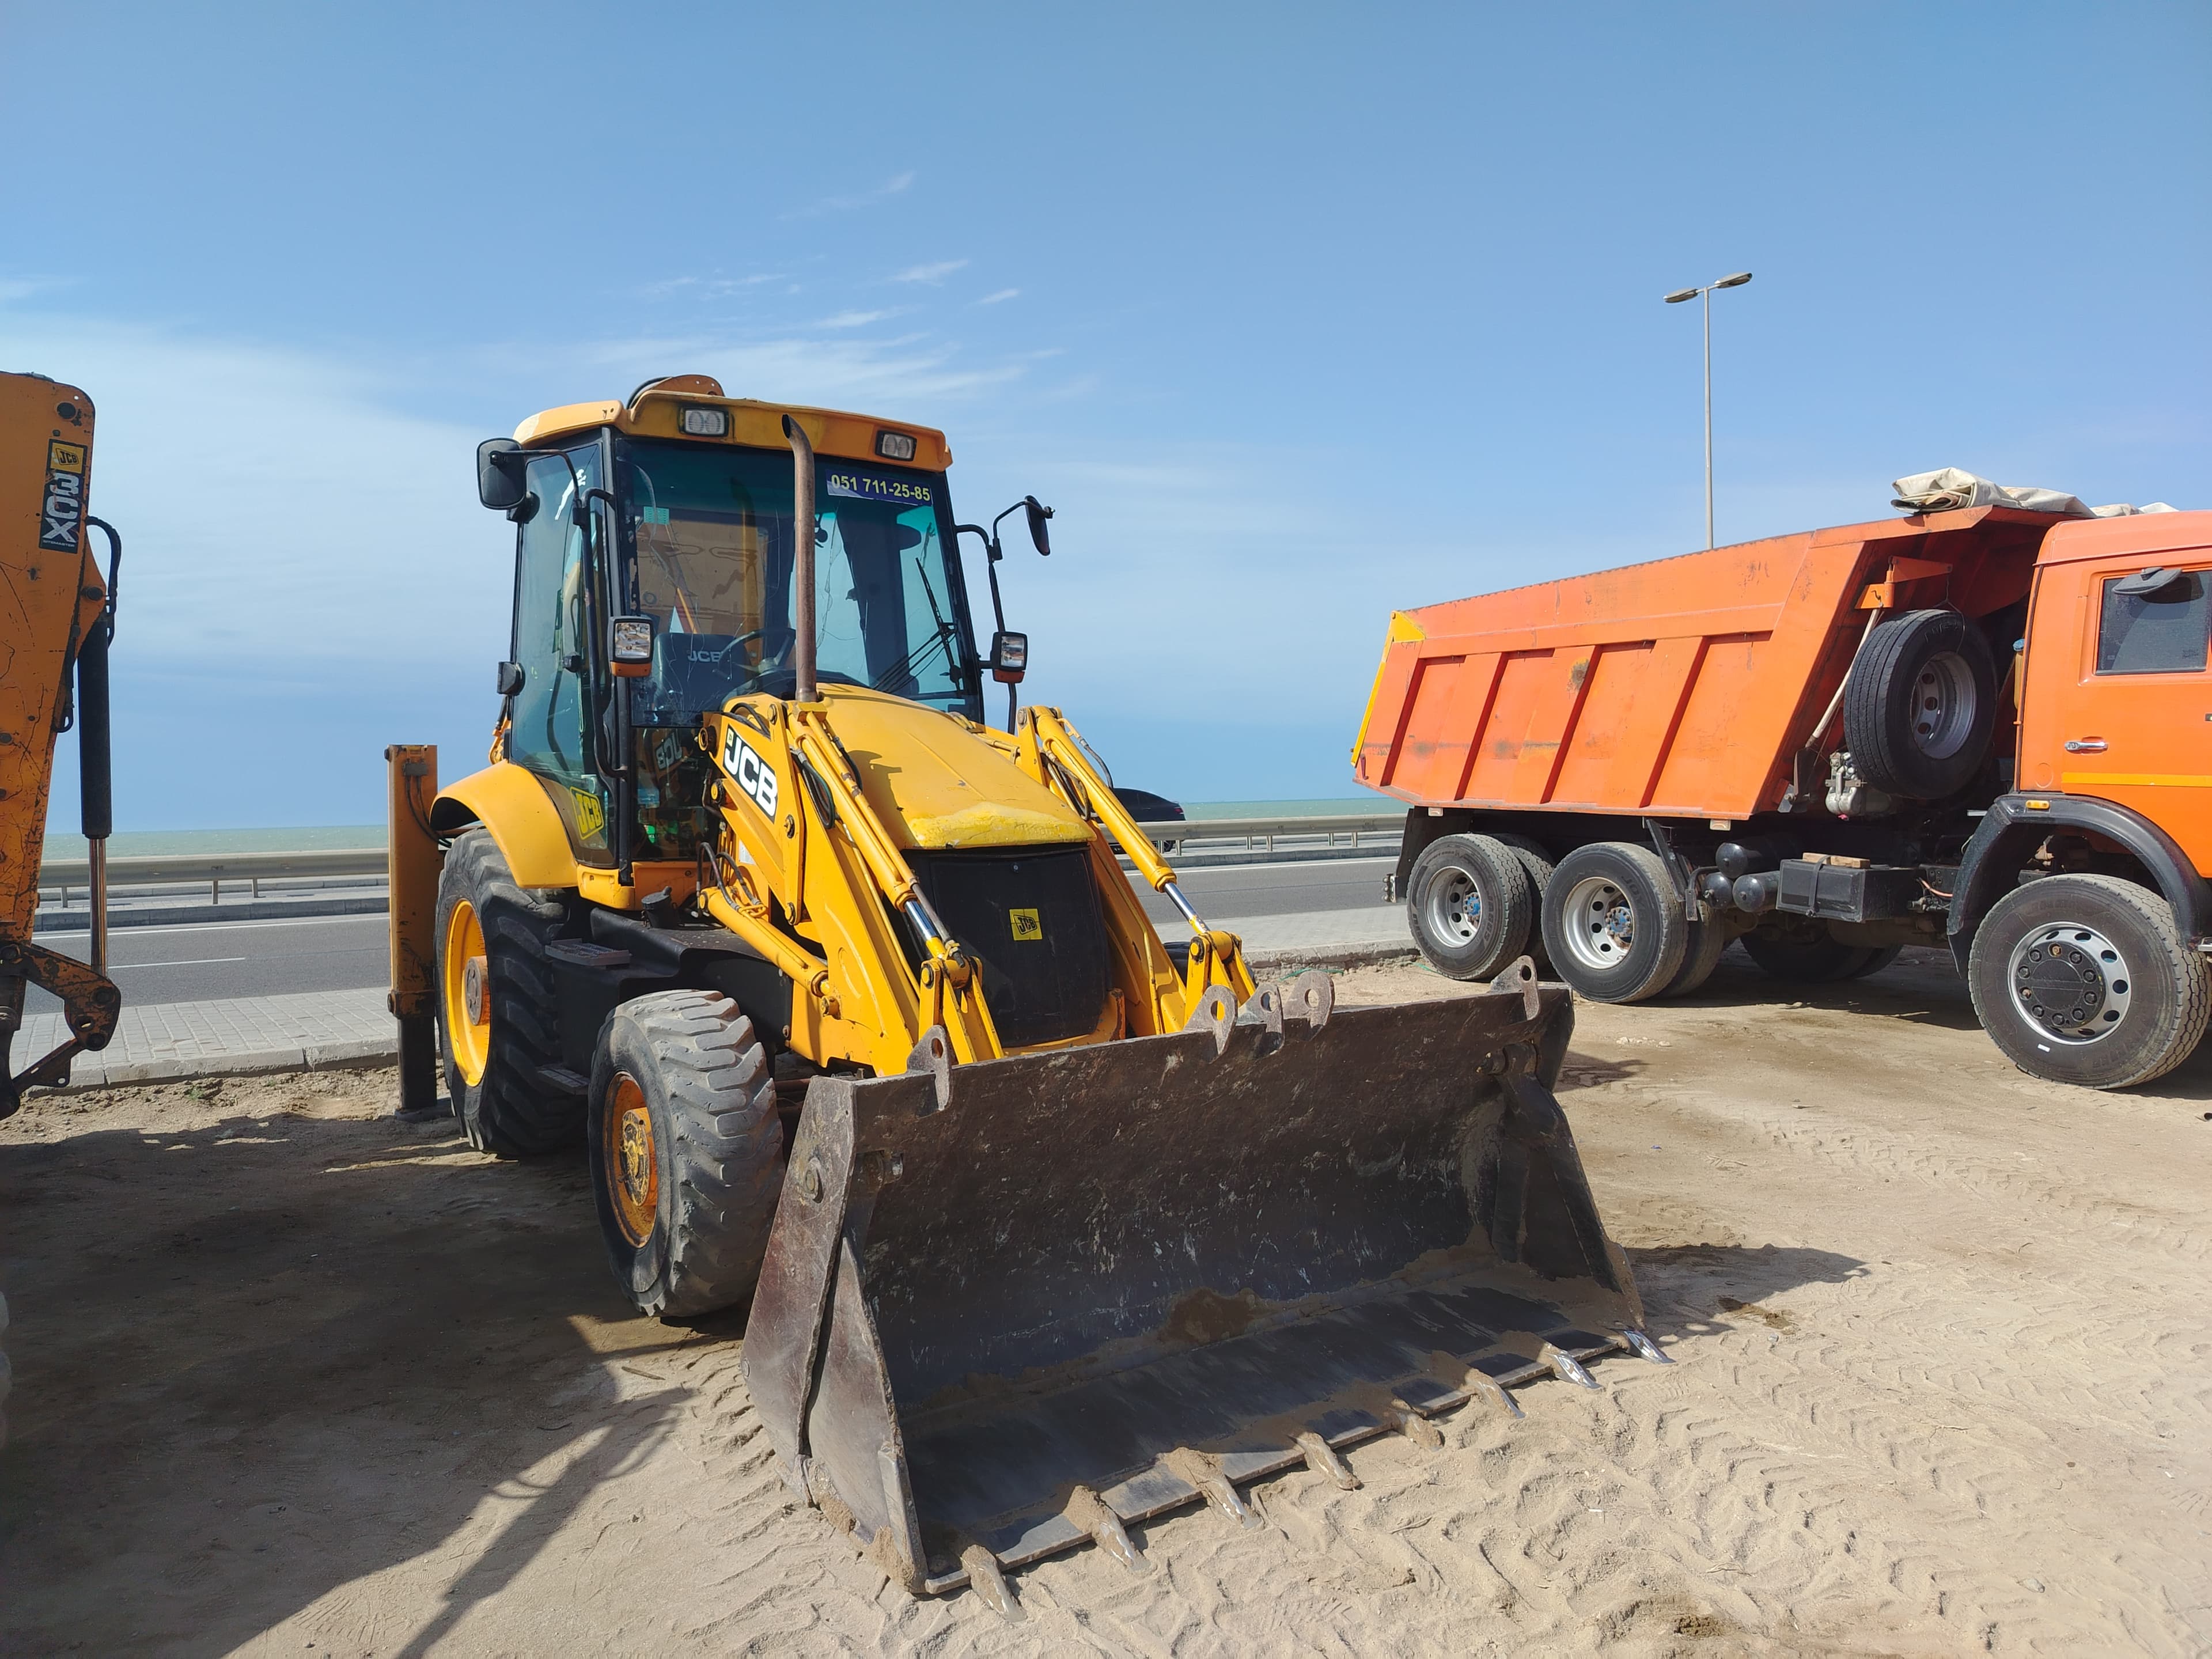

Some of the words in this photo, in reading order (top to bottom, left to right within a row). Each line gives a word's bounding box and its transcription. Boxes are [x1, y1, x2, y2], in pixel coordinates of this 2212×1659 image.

[59, 451, 78, 464] JCB
[831, 475, 857, 491] 051
[862, 478, 930, 501] 711-25-85
[42, 472, 79, 543] 3CX
[725, 736, 778, 817] JCB
[575, 793, 602, 834] JCB
[1017, 917, 1036, 933] JCB
